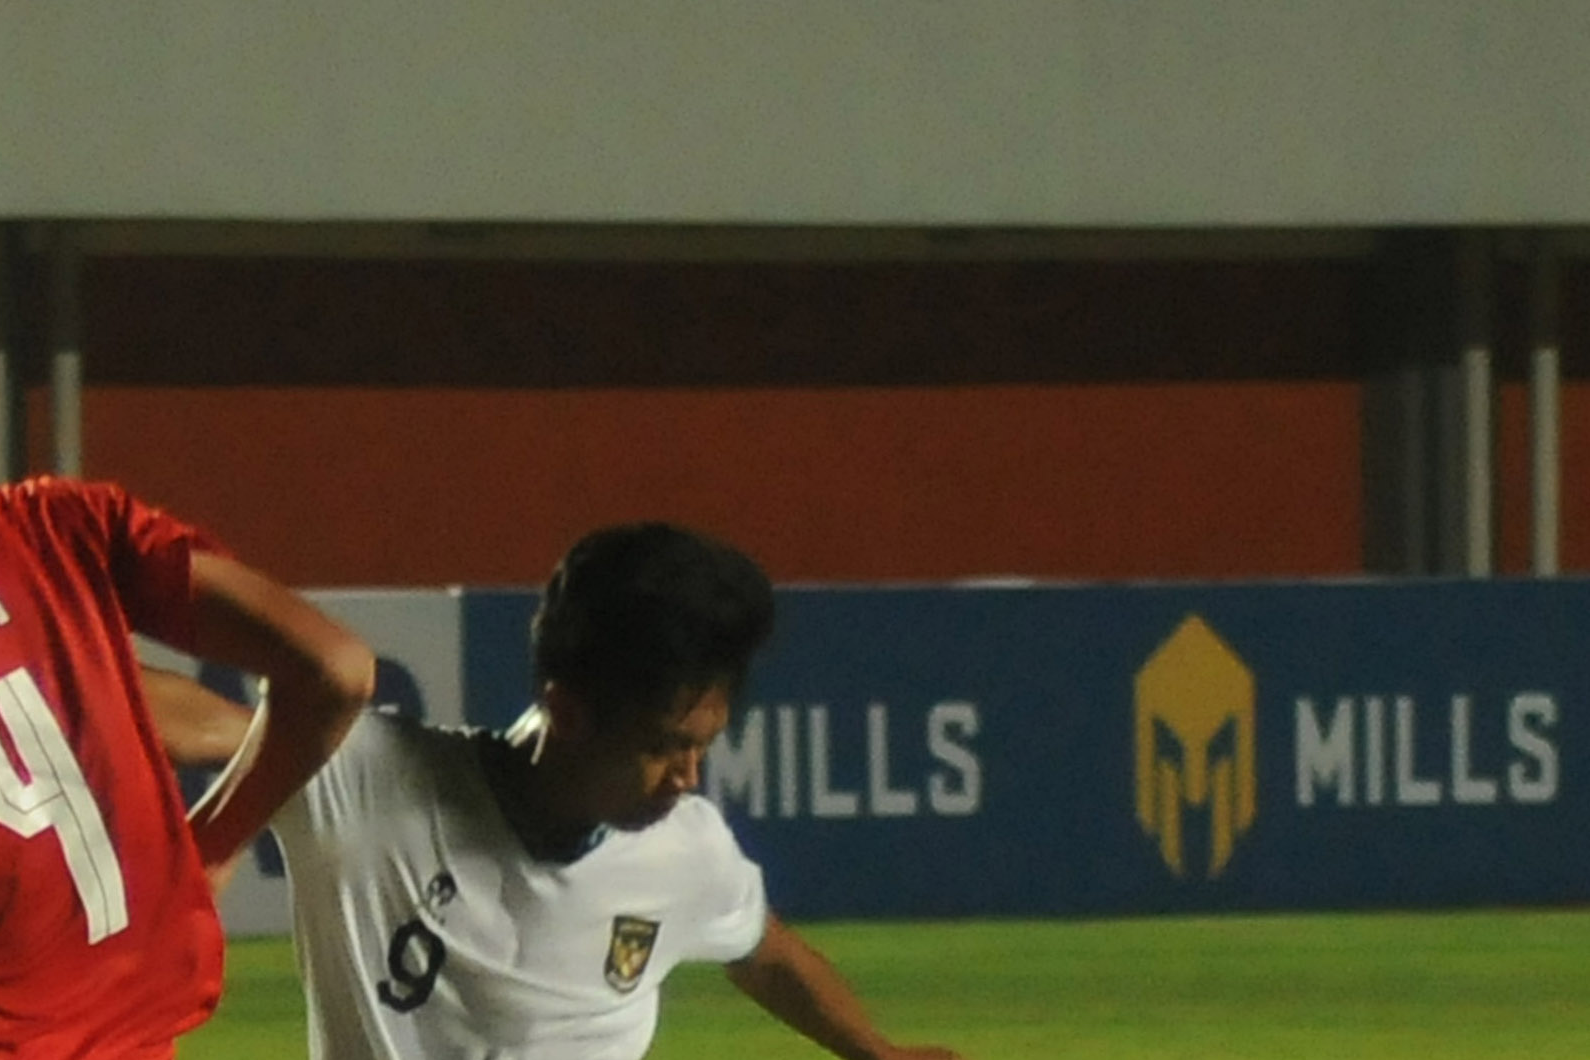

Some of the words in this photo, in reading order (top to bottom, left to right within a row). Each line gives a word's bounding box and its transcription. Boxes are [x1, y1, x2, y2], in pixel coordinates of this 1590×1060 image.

[706, 703, 982, 818] MILLS
[1295, 691, 1558, 806] MILLS
[376, 918, 446, 1014] 9
